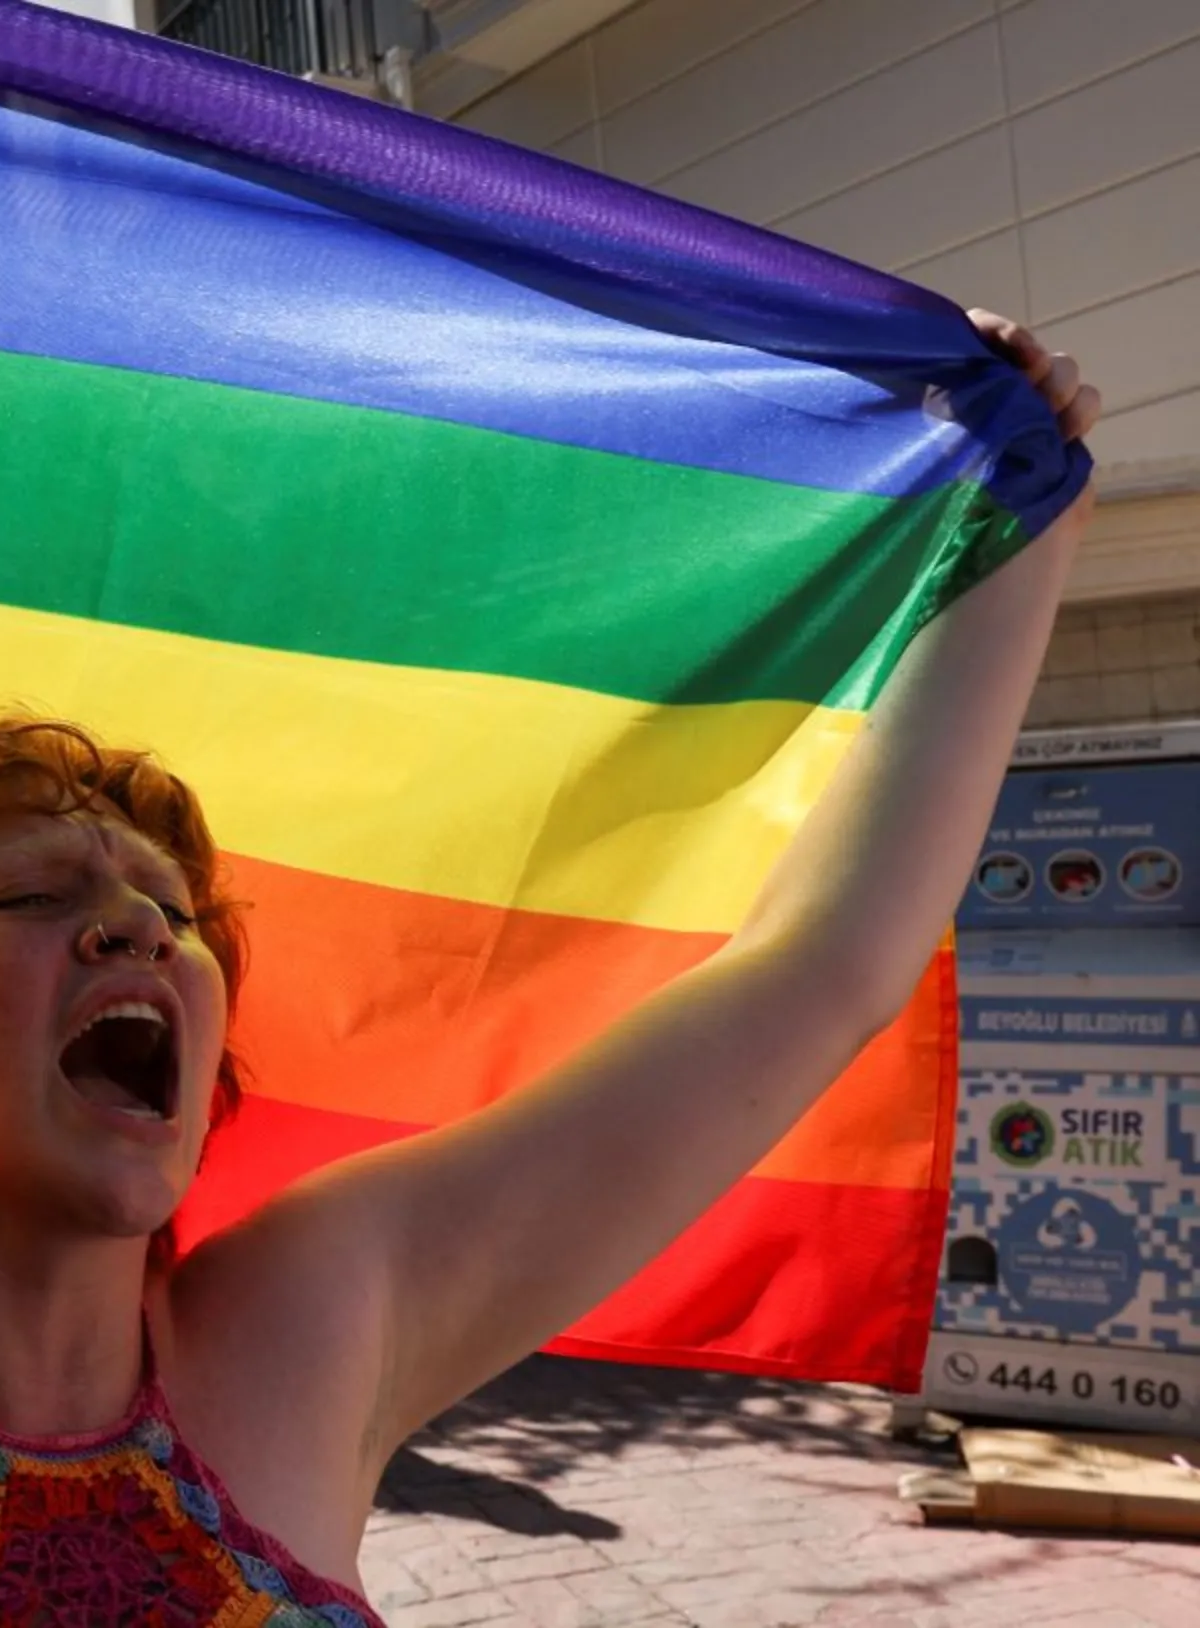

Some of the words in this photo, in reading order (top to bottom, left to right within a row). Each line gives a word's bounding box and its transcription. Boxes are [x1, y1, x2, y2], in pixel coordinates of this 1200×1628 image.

[977, 1009, 1058, 1033] BEYOĞLU
[1061, 1010, 1169, 1035] BELEDİYESİ
[1061, 1108, 1143, 1136] SIFIR
[1062, 1138, 1143, 1167] ATIK
[988, 1362, 1058, 1396] 444
[1072, 1371, 1095, 1400] 0
[1110, 1375, 1181, 1410] 160
